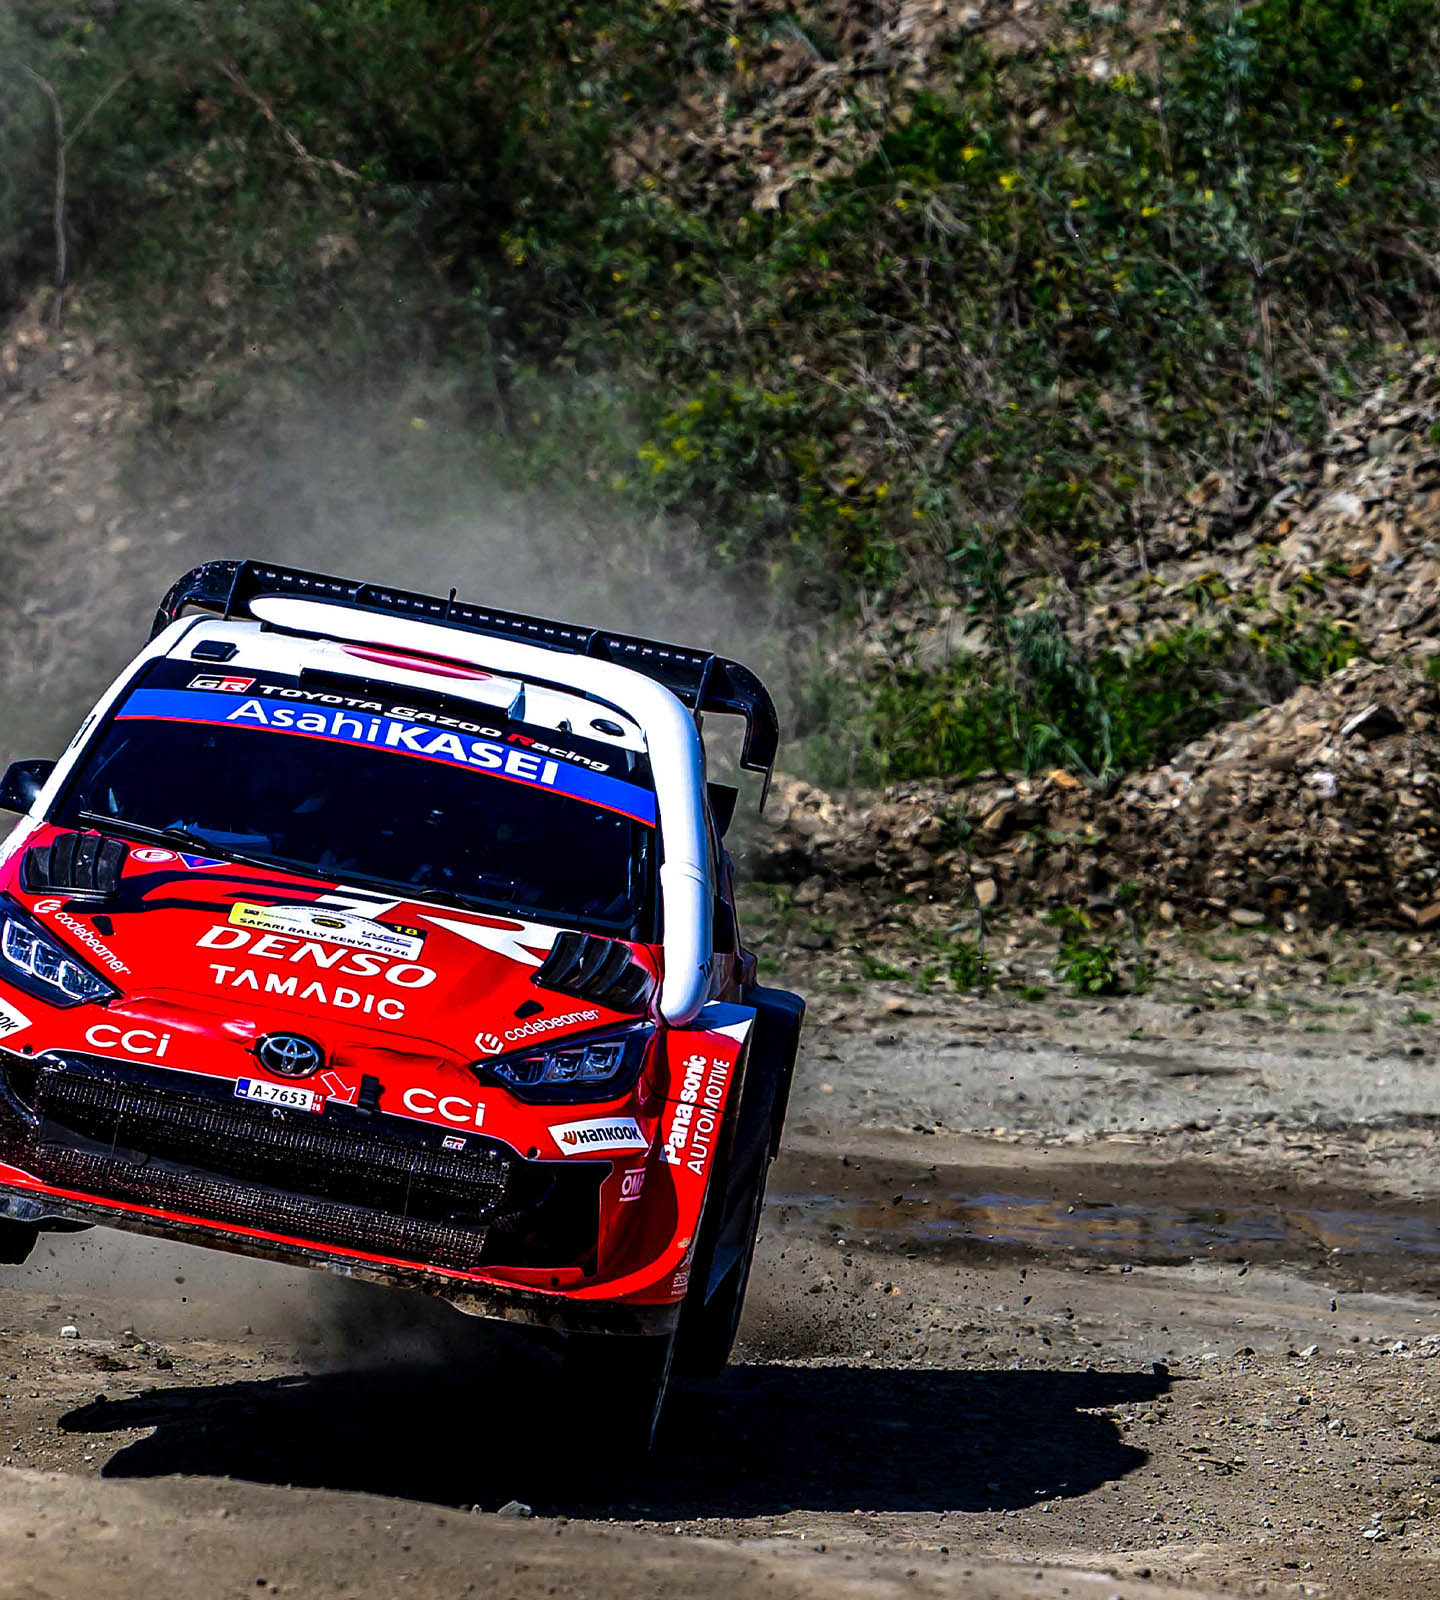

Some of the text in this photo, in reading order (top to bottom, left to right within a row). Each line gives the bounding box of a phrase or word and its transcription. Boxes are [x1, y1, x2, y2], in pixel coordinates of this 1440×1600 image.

[191, 677, 249, 693] GR
[260, 684, 610, 772] TOYOTA GAZOO Racing
[54, 911, 132, 975] codebeamer
[196, 924, 438, 989] DENSO
[239, 918, 285, 931] SAFARI
[288, 926, 328, 939] RALLY
[330, 935, 372, 948] KENYA
[375, 945, 409, 957] 2026
[209, 963, 405, 1021] TAMADIC
[504, 1009, 599, 1041] codebeamer
[252, 1084, 308, 1106] A-7653
[664, 1054, 707, 1166] Panasonic
[687, 1058, 730, 1176] AUTOMOTIVE
